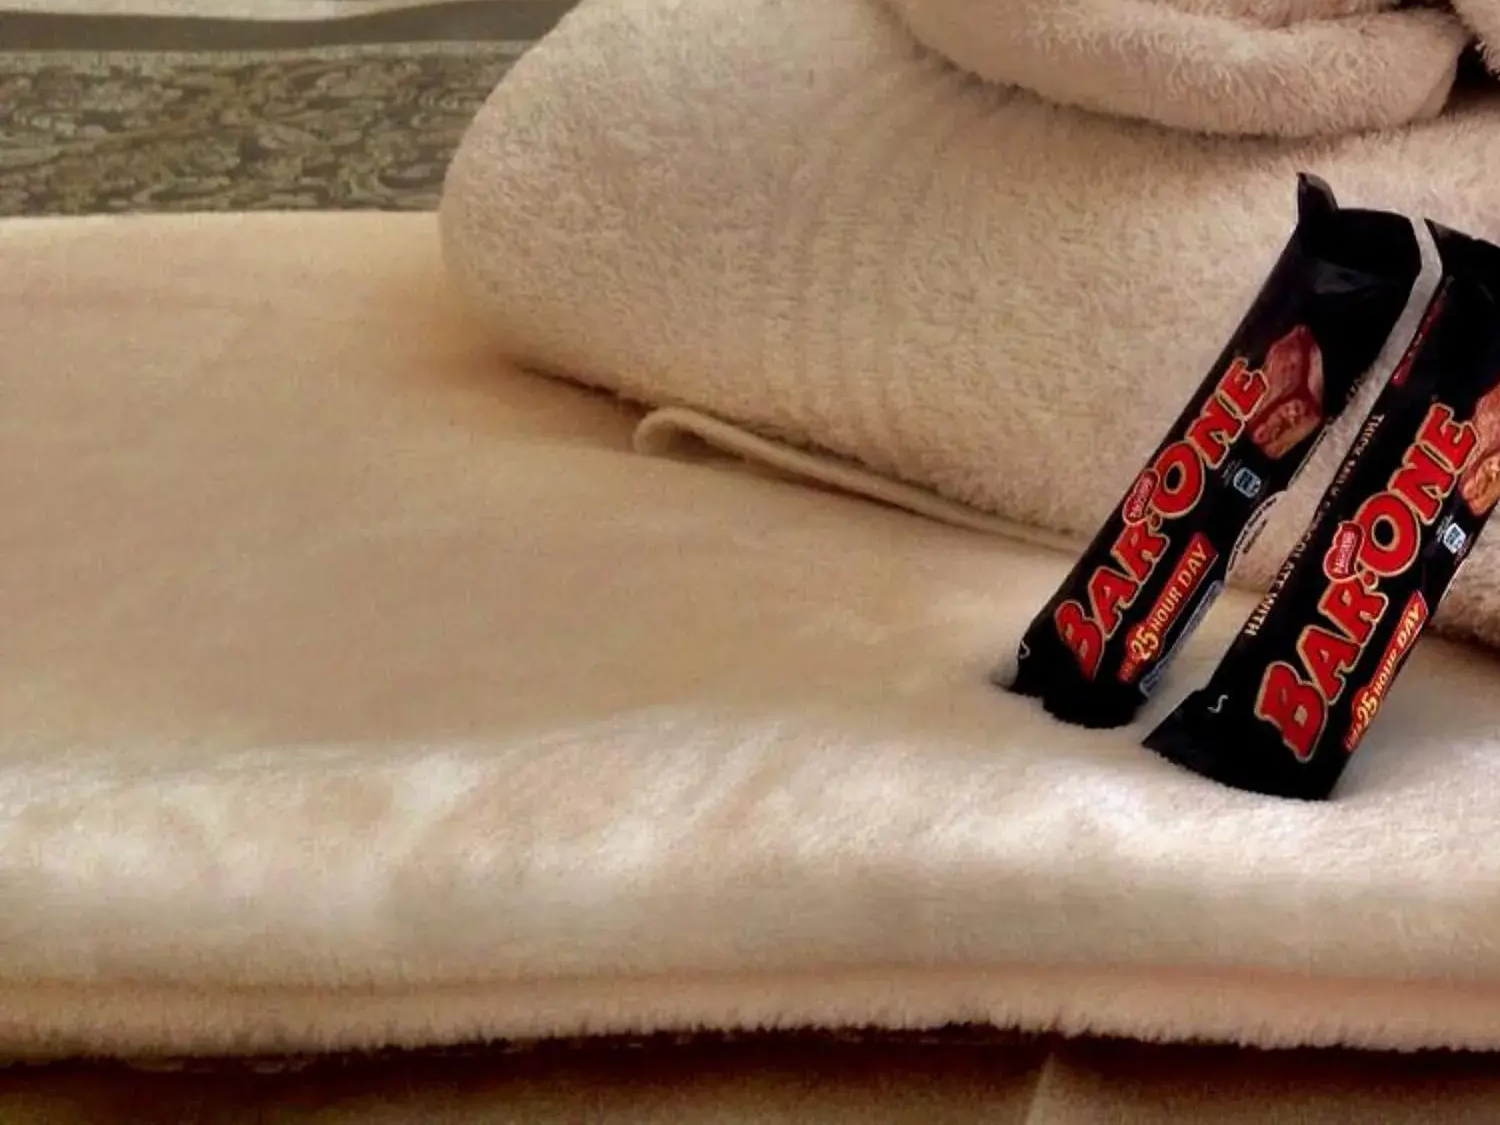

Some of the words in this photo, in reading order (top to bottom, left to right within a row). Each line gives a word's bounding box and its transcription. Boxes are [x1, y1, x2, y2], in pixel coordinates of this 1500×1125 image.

[1129, 625, 1160, 662] 25
[1147, 584, 1183, 633] HOUR
[1176, 543, 1209, 588] DAY
[1351, 690, 1381, 728] 25
[1393, 601, 1424, 647] DAY
